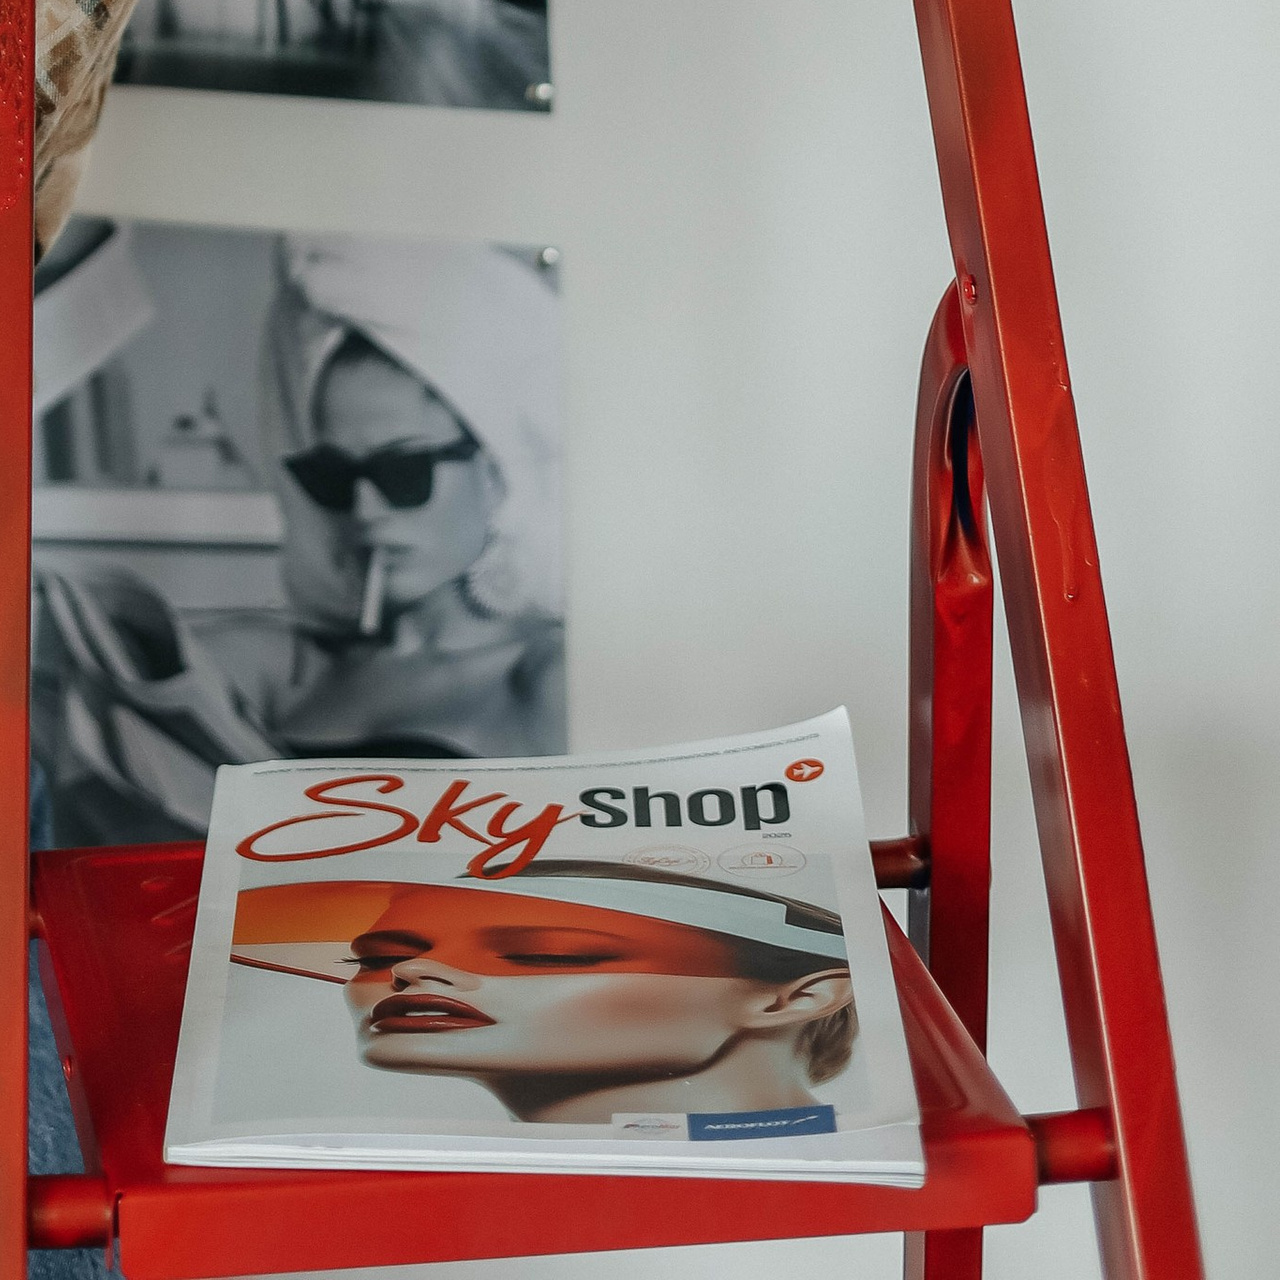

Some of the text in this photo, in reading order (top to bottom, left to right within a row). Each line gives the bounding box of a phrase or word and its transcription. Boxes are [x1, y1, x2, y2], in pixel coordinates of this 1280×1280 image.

[235, 773, 791, 880] Sky shop
[704, 1118, 791, 1131] AEROFLOT
